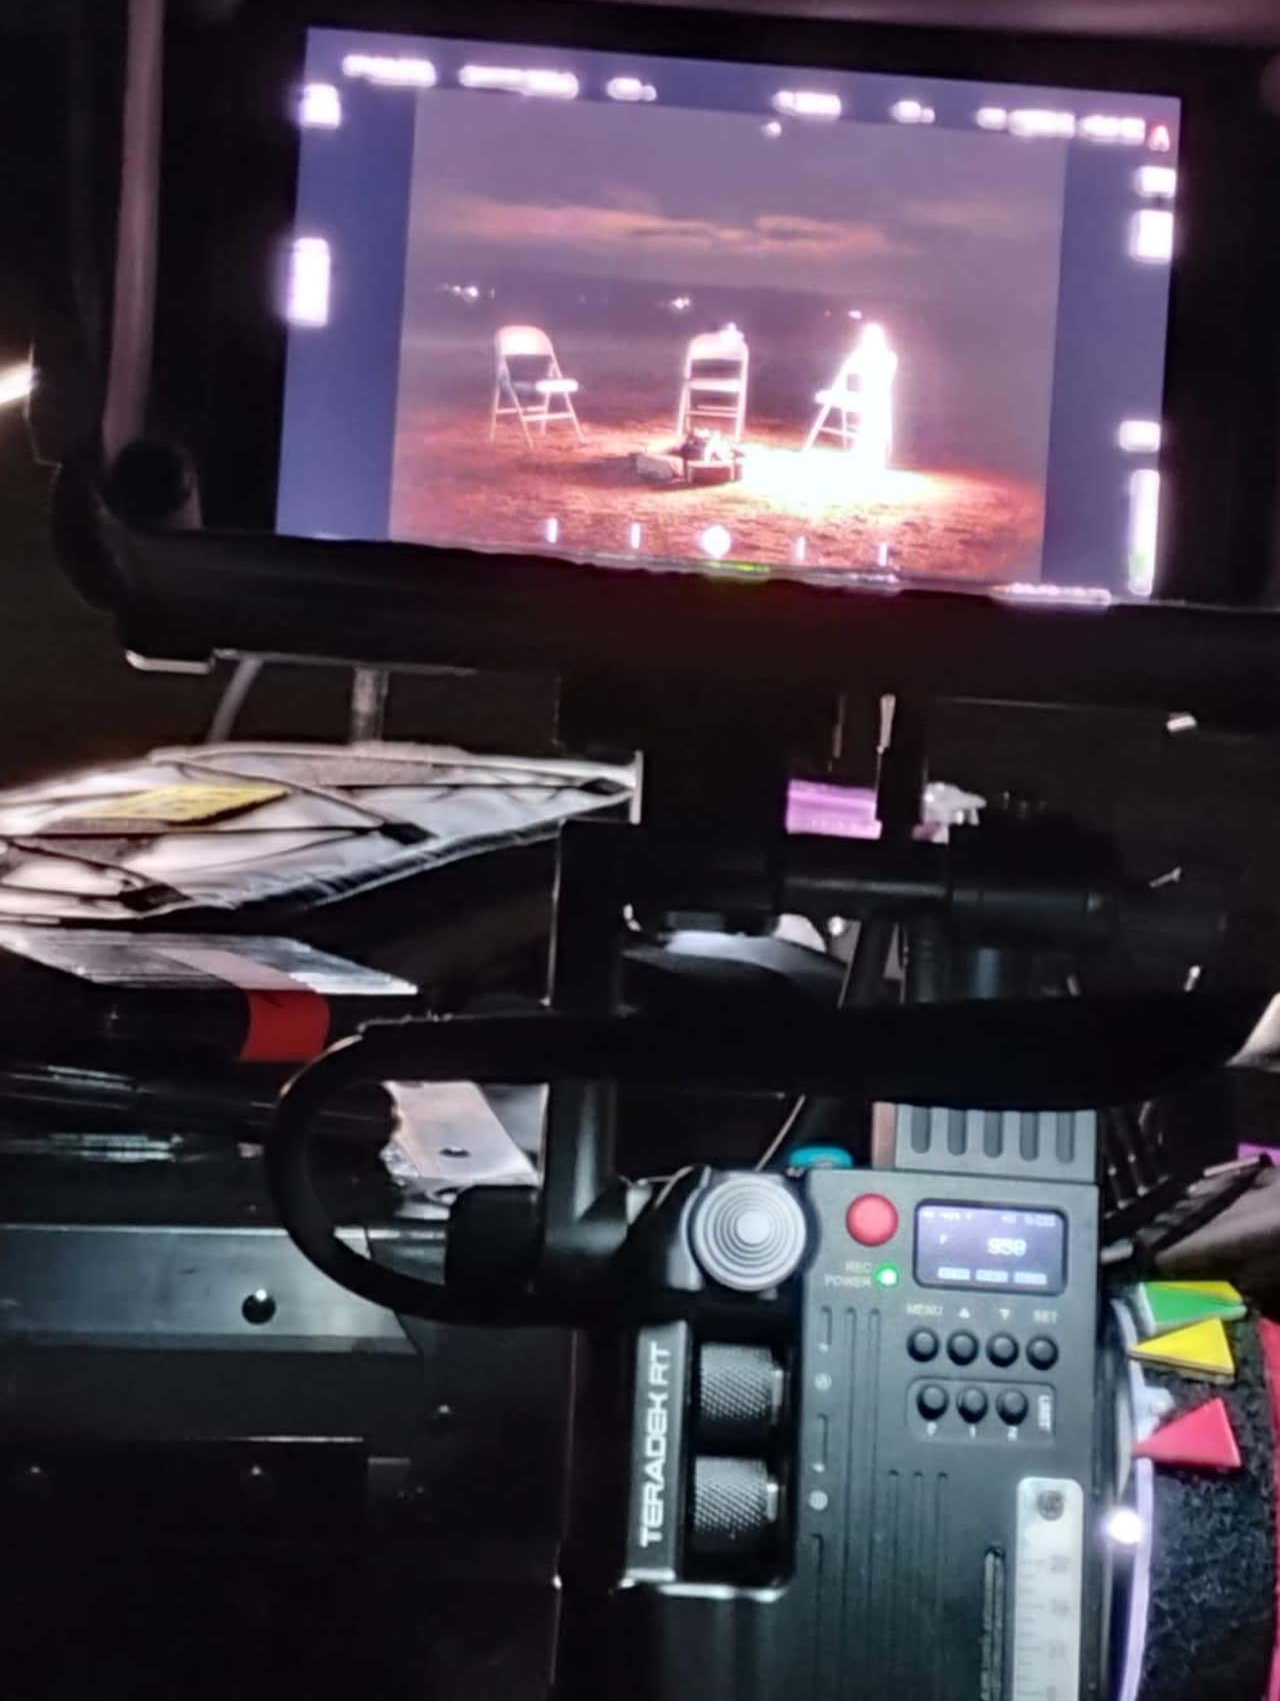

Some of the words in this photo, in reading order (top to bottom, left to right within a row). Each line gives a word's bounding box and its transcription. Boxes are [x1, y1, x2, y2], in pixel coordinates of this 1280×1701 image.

[845, 1259, 873, 1274] REC
[824, 1273, 872, 1288] POWER
[906, 1302, 943, 1316] MENU
[1032, 1309, 1058, 1324] SET
[647, 1339, 671, 1386] RT
[639, 1390, 669, 1549] TERADEK
